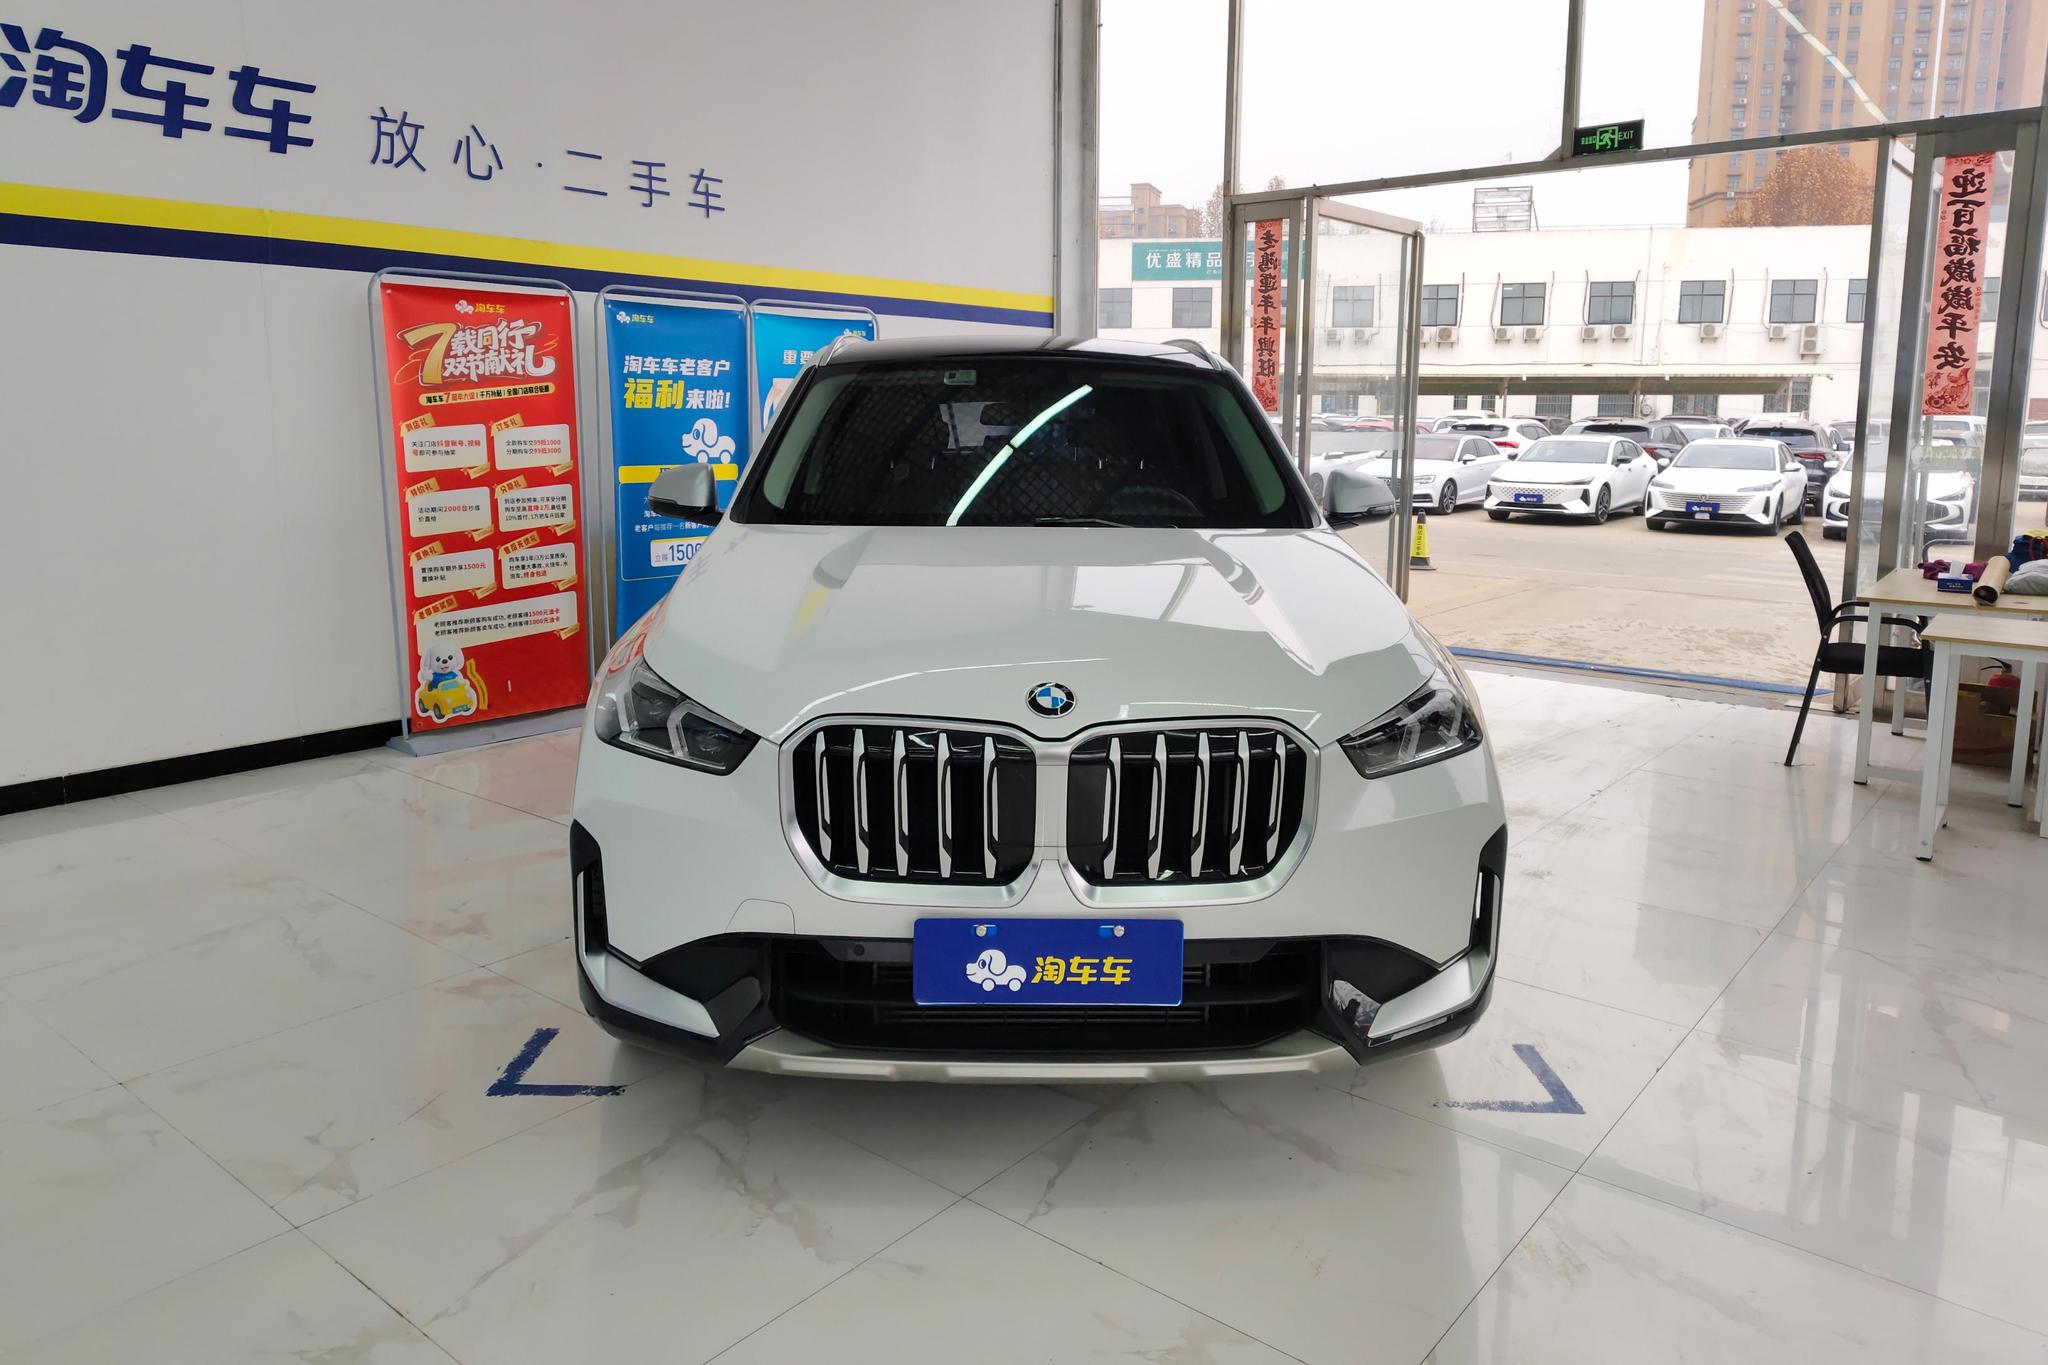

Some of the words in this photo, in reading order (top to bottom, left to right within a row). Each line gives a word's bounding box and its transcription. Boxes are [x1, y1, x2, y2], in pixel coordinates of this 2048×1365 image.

[0, 23, 316, 154] 淘车车
[1618, 130, 1634, 141] EXIT
[475, 303, 506, 314] 淘车车
[631, 313, 655, 323] 淘车车
[443, 345, 556, 382] 双节献礼
[623, 355, 731, 377] 淘车车老客户
[1031, 955, 1133, 985] 淘车车
